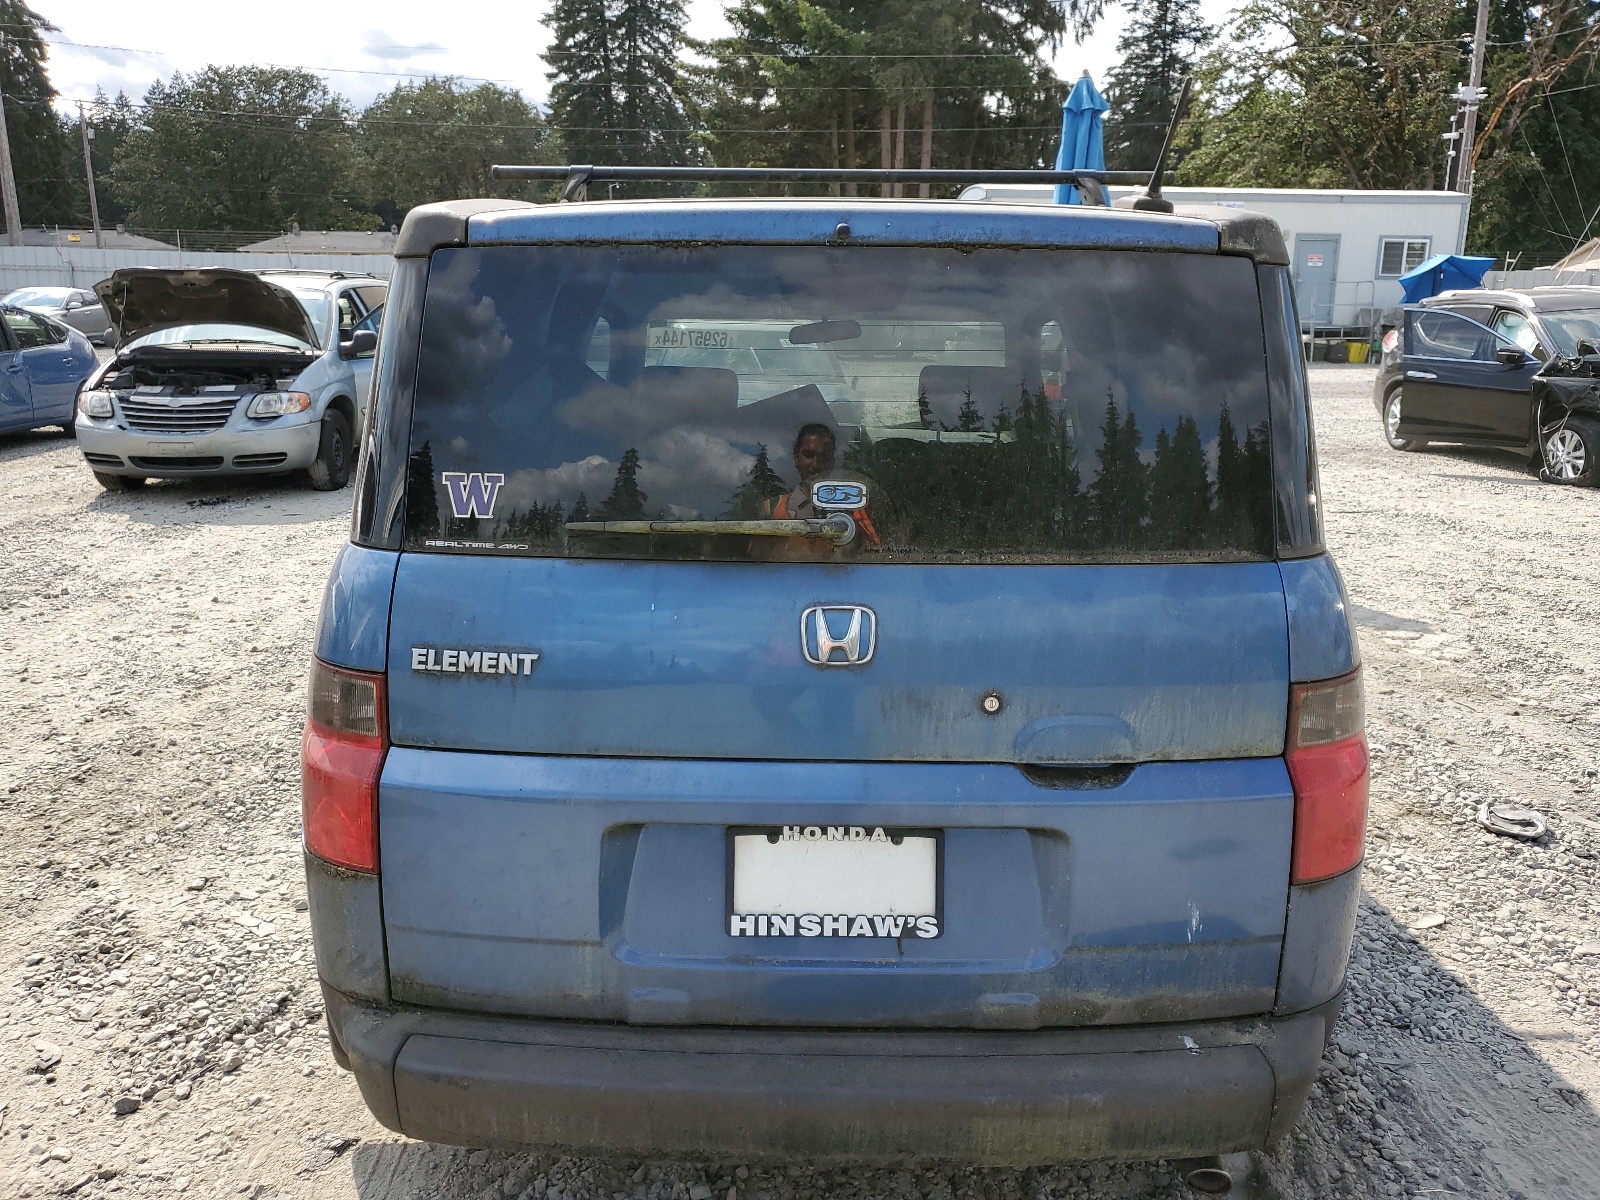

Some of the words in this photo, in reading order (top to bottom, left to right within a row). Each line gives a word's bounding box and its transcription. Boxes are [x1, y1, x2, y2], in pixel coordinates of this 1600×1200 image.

[442, 471, 505, 519] W
[411, 648, 540, 675] ELEMENT
[782, 825, 889, 843] HONDA
[730, 914, 939, 939] HINSHAW'S
